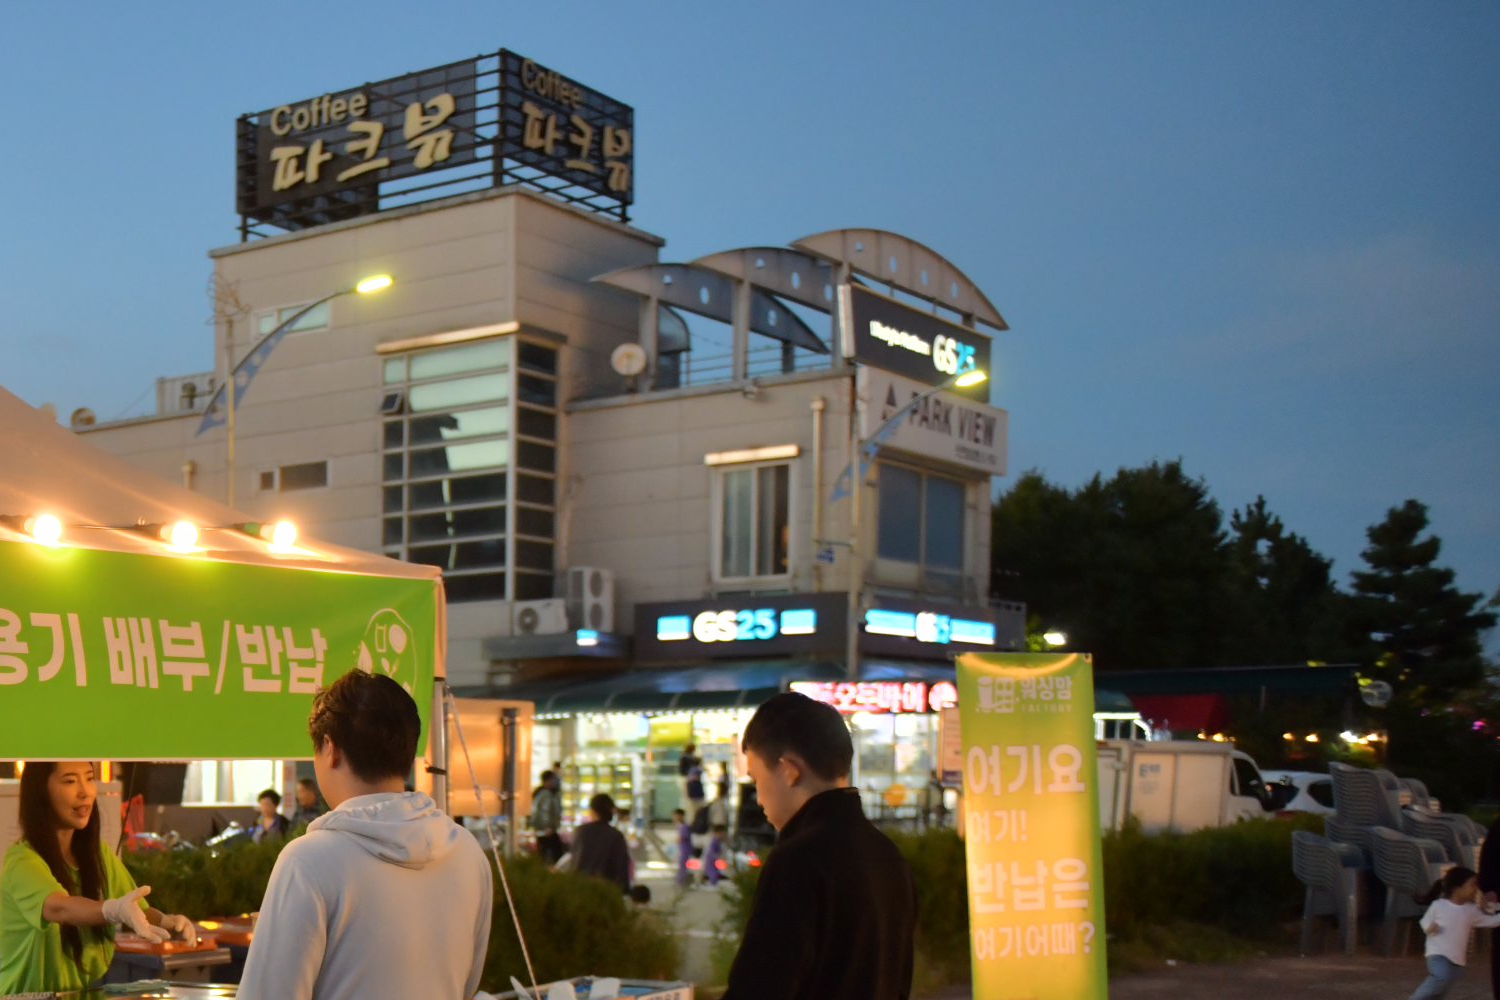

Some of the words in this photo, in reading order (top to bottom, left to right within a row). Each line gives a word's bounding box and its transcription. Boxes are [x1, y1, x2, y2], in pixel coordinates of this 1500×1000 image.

[521, 58, 582, 109] Coffee
[269, 92, 368, 136] Coffee
[270, 93, 457, 191] 파크뷰
[933, 334, 976, 376] GS25
[909, 390, 954, 436] PARK
[957, 406, 997, 447] VIEW
[693, 609, 776, 643] GS25
[102, 615, 328, 696] 배부/반납
[1021, 676, 1072, 700] 워싱맘
[967, 744, 1086, 796] 여기요
[970, 810, 1028, 844] 여기!
[973, 857, 1091, 914] 반납은
[975, 921, 1096, 961] 여기어때?
